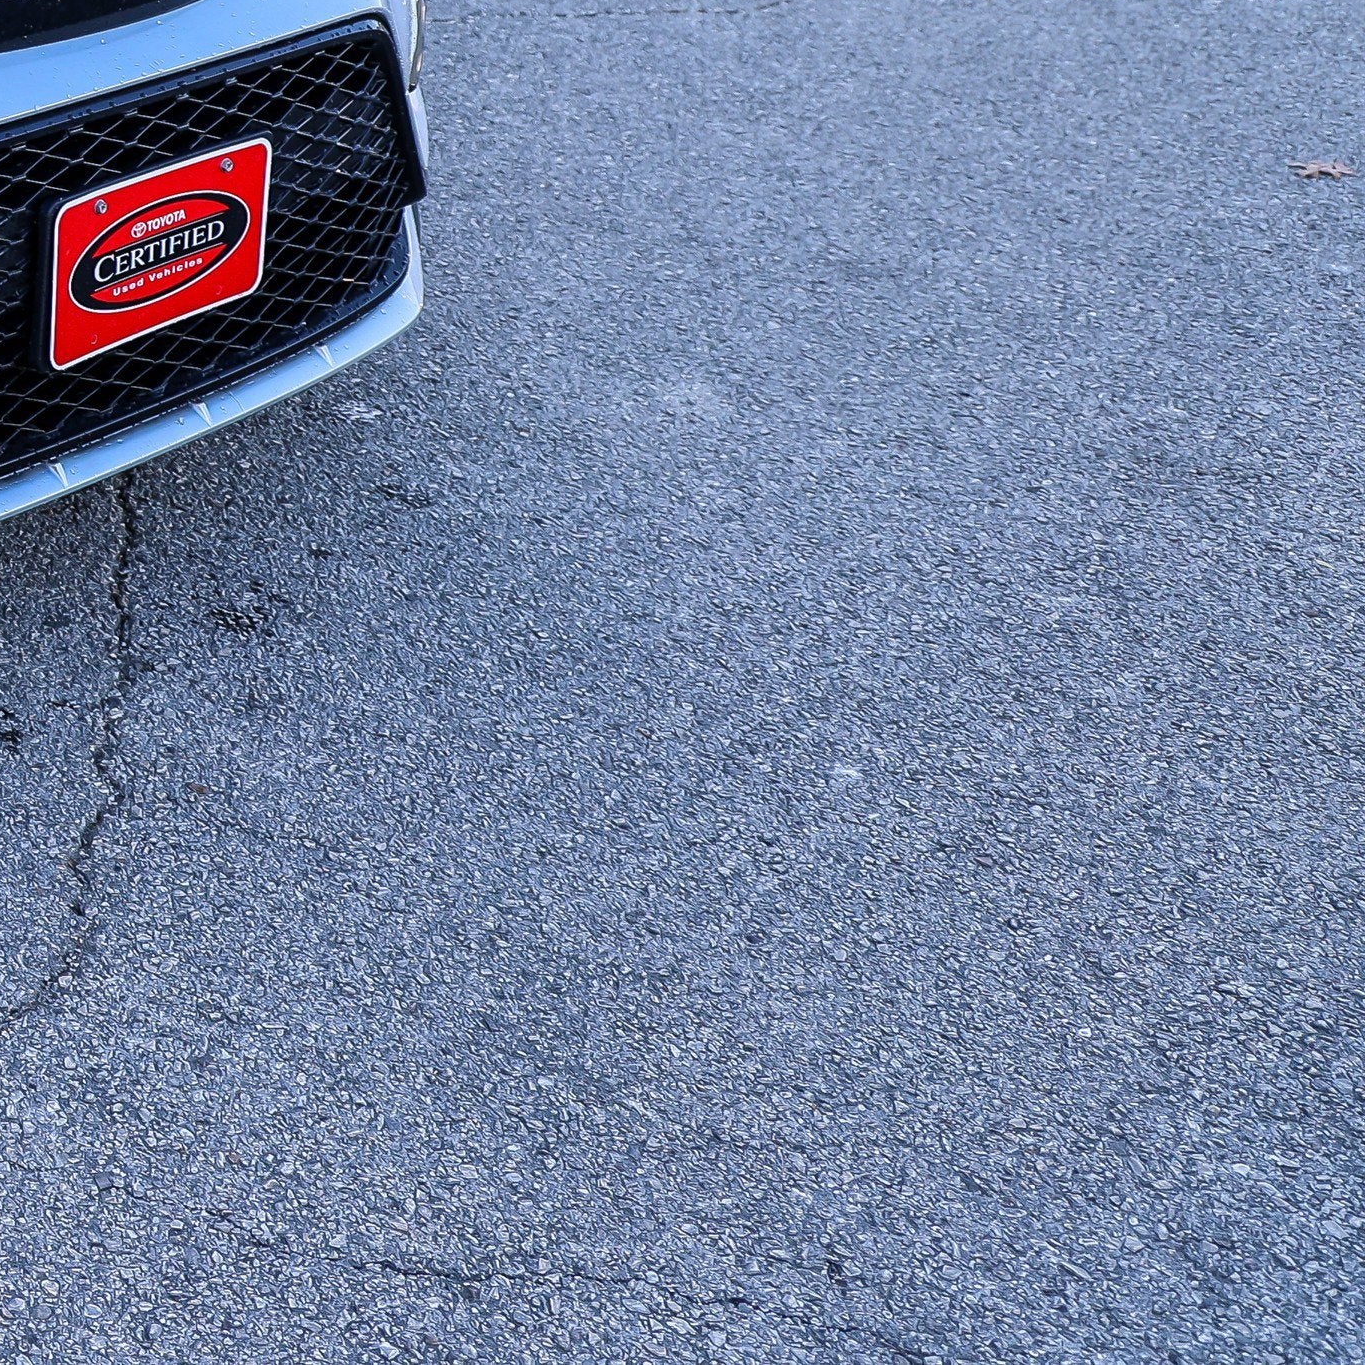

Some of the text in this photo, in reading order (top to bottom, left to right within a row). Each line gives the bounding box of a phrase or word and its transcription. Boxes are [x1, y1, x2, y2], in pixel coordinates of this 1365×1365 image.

[147, 209, 186, 233] TOYOTA
[93, 220, 225, 283] CERTIFIED
[112, 257, 203, 296] Used Vehicles
